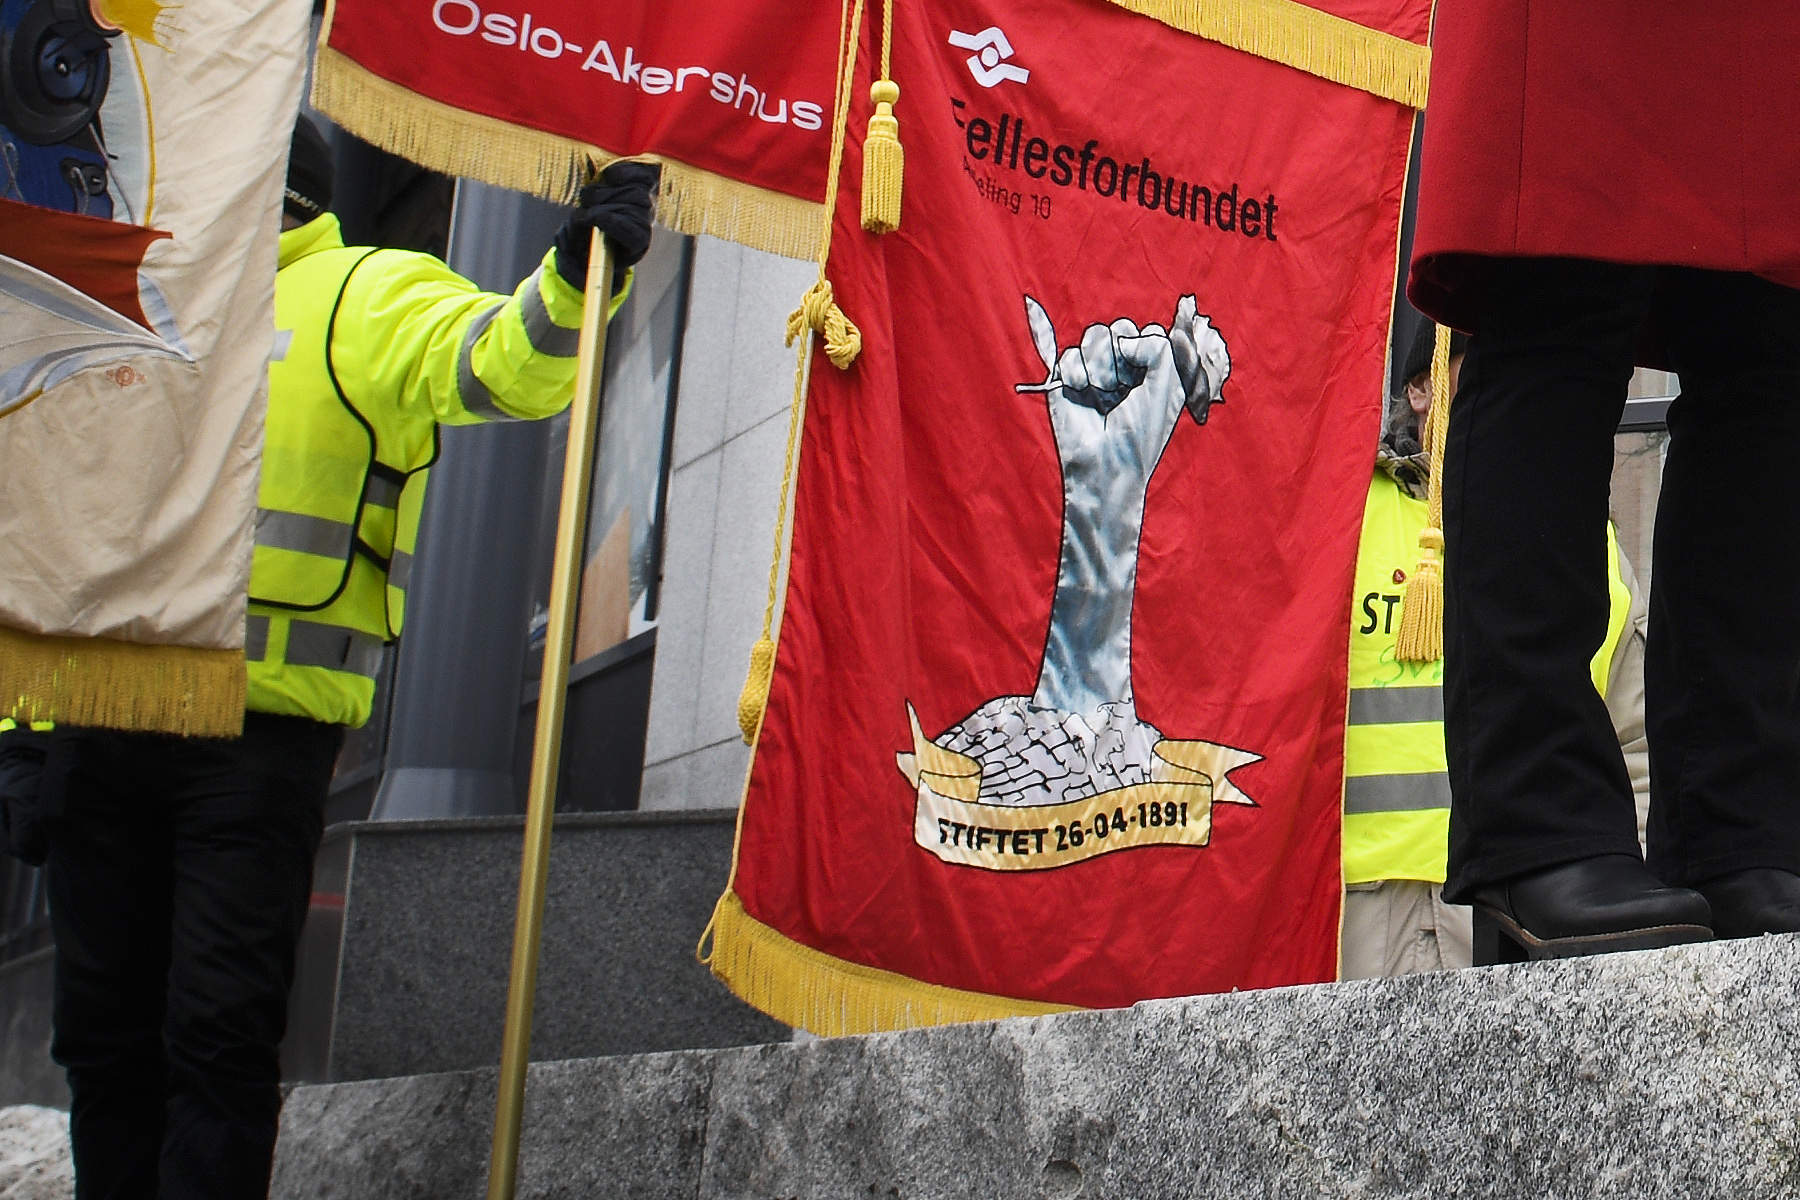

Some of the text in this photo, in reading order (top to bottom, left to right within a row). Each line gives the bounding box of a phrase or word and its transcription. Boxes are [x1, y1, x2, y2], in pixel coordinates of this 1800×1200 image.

[1031, 193, 1051, 220] 10
[938, 801, 1189, 856] STIFTET 26-04-1891
